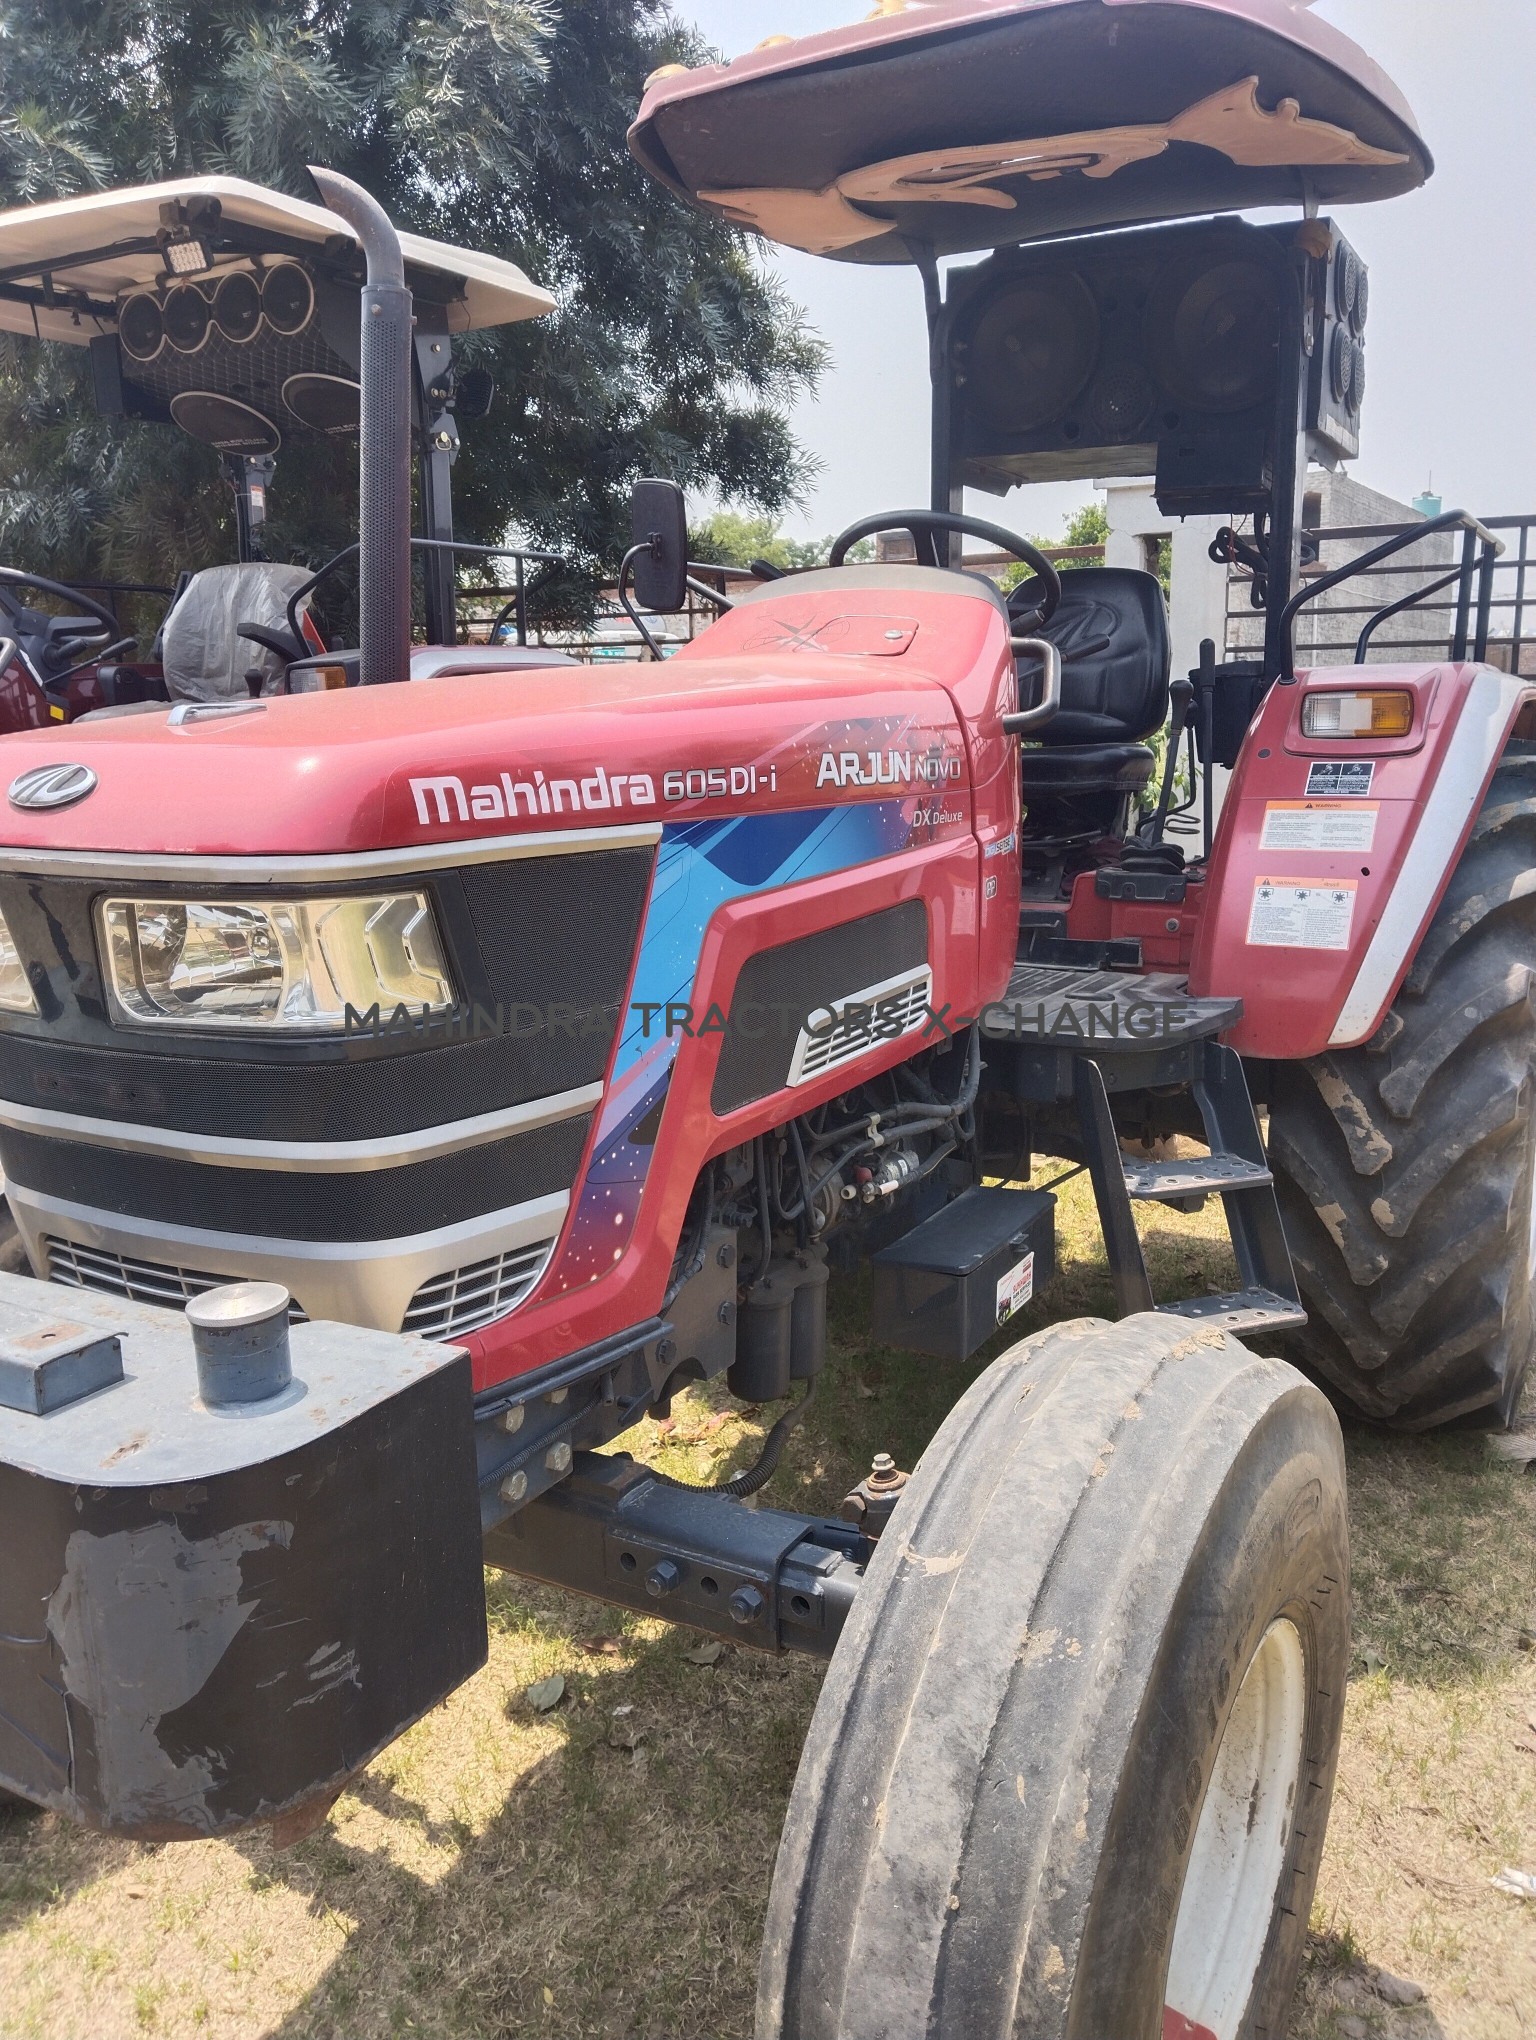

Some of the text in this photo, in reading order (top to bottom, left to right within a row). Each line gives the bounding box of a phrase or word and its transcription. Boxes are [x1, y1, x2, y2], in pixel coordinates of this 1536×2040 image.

[815, 751, 961, 789] ARJUN NOVO
[408, 767, 656, 825] Mahindra
[662, 768, 728, 801] 605
[912, 810, 963, 827] DX Deluxe
